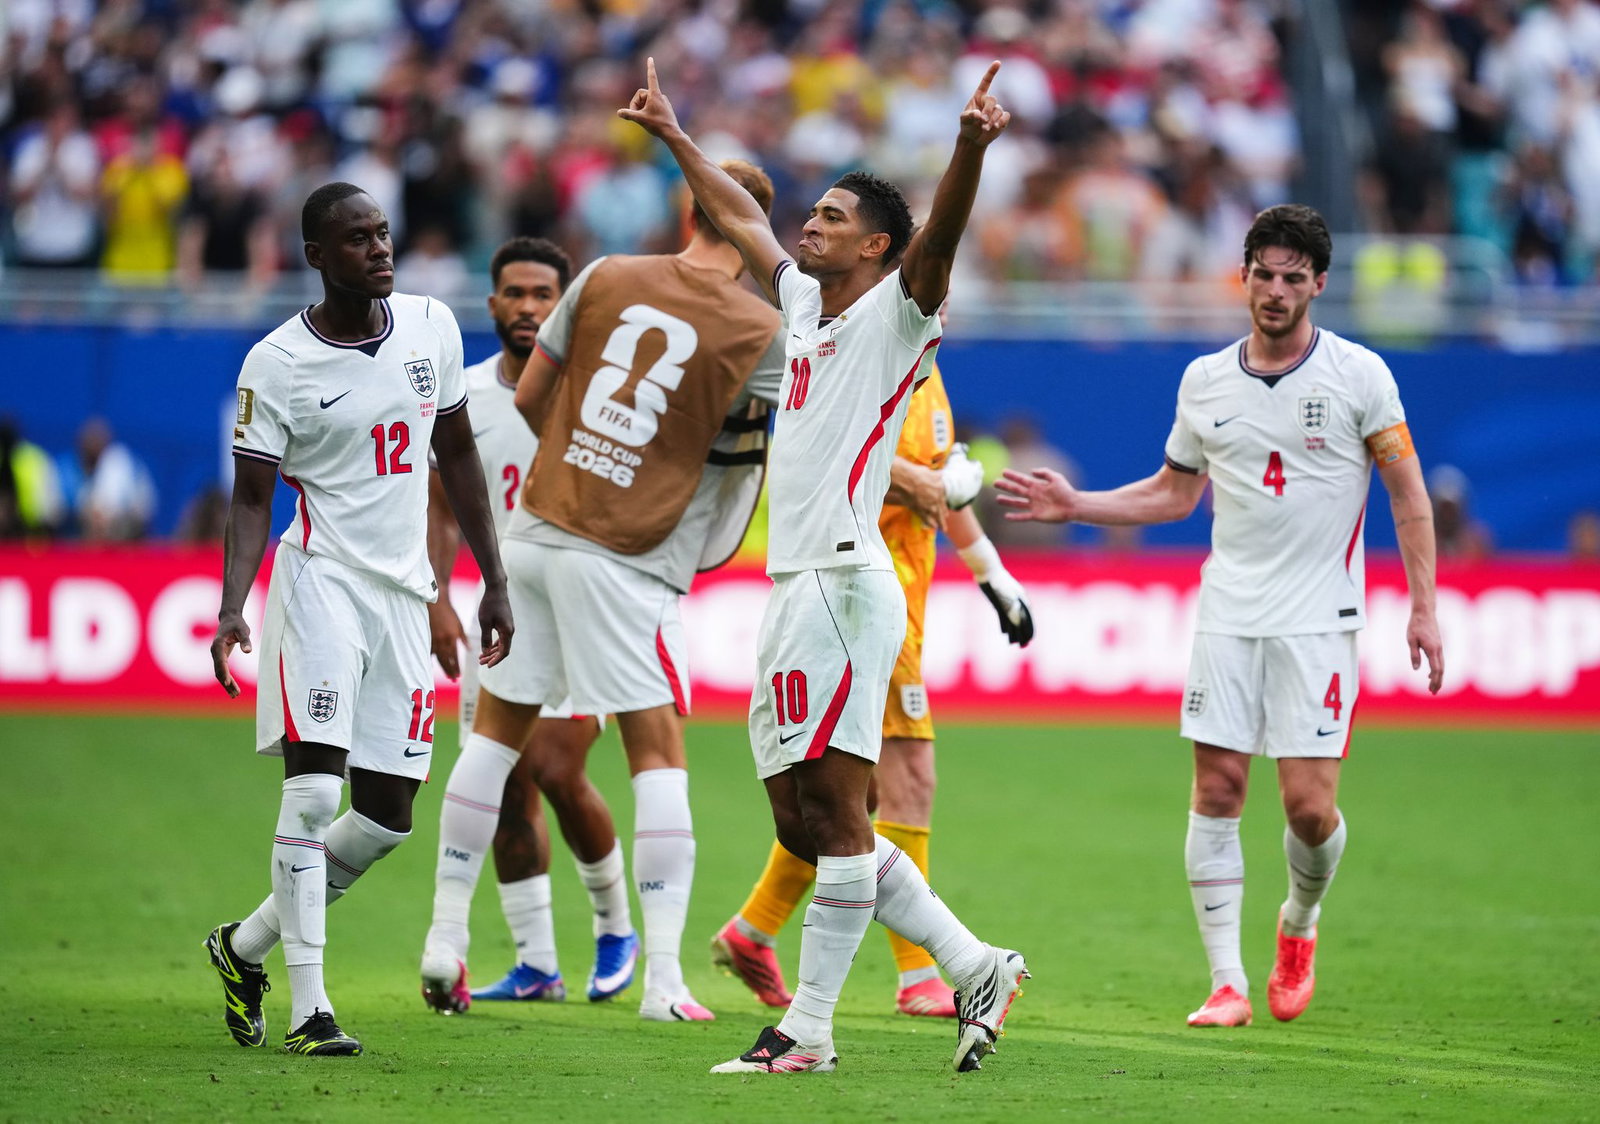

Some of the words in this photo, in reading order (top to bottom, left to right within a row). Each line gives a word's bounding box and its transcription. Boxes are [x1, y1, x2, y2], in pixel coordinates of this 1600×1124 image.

[786, 357, 811, 410] 10
[598, 406, 632, 430] FIFA
[371, 421, 413, 476] 12
[563, 443, 635, 488] 2026
[572, 428, 613, 454] WORLD
[612, 446, 643, 467] CUP
[1263, 451, 1286, 496] 4
[408, 688, 434, 743] 12
[772, 670, 808, 726] 10
[1324, 672, 1342, 721] 4
[640, 880, 665, 893] ENG
